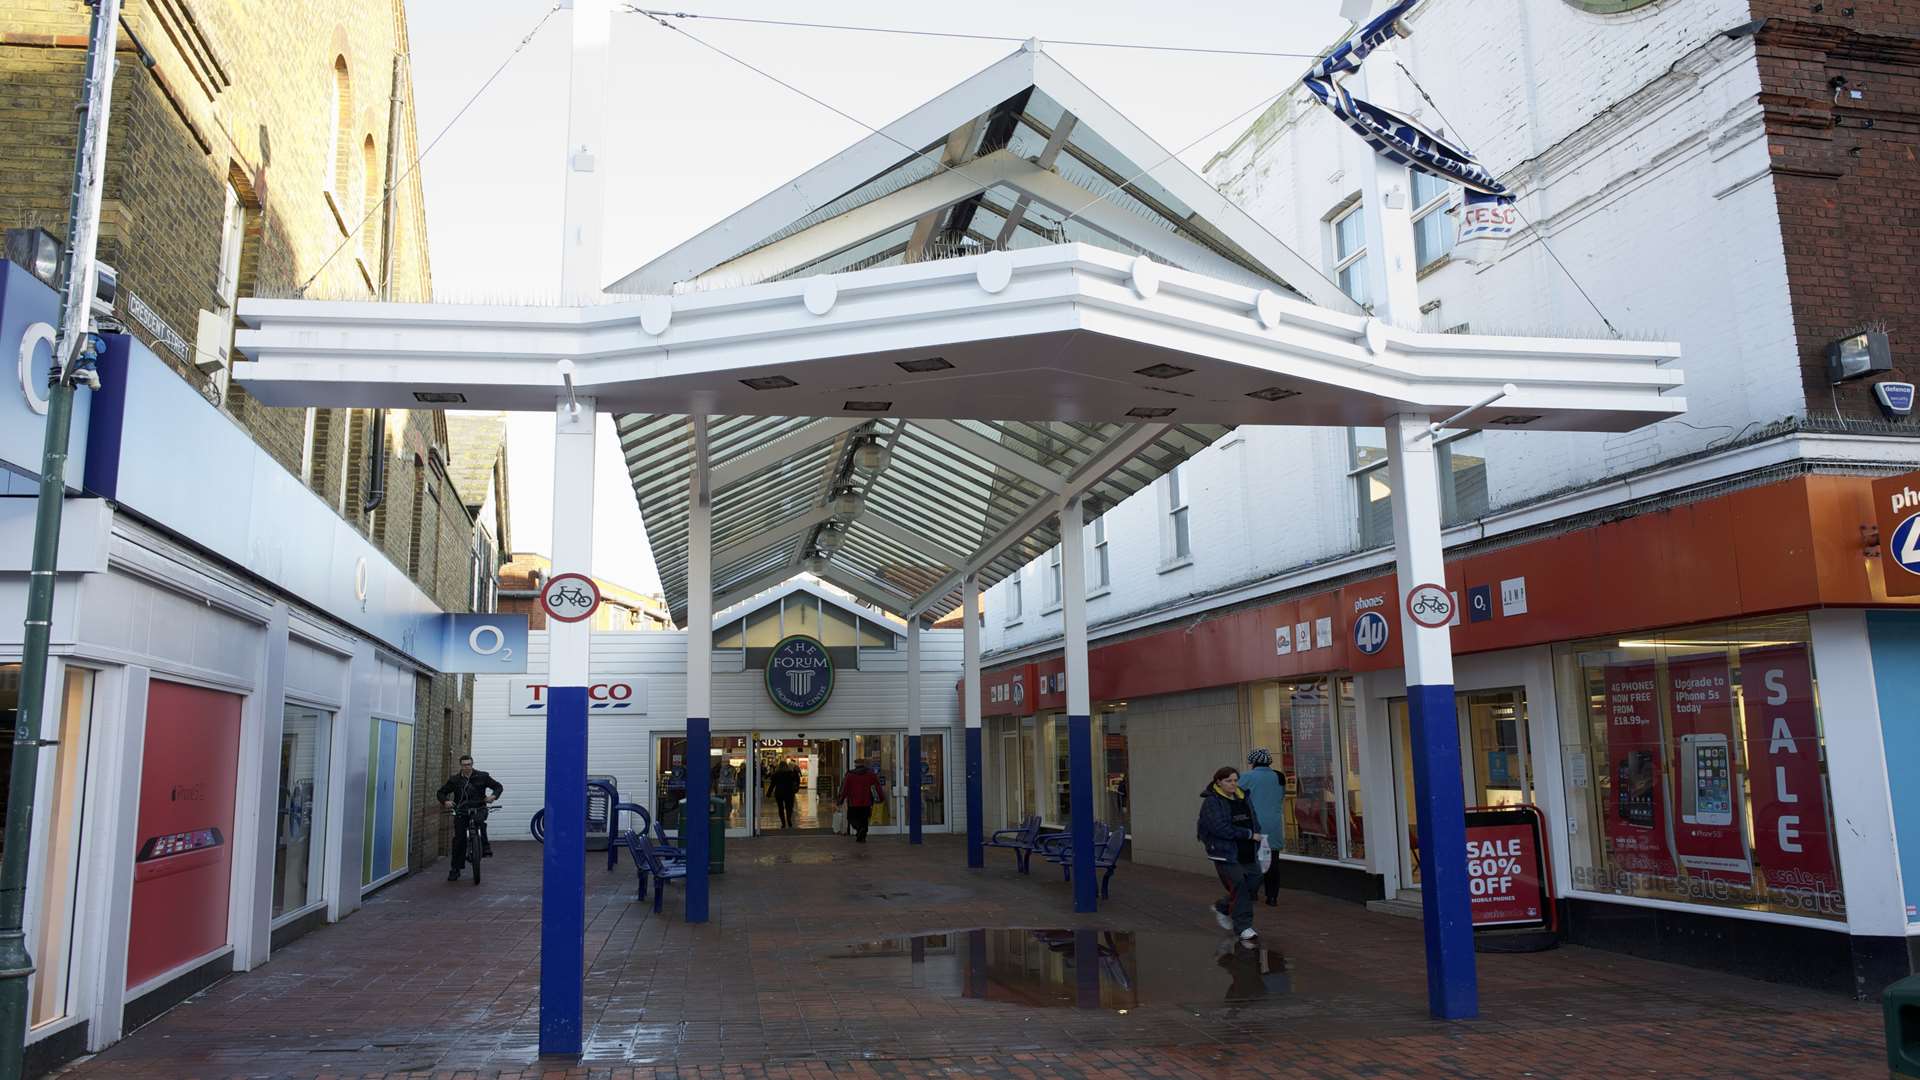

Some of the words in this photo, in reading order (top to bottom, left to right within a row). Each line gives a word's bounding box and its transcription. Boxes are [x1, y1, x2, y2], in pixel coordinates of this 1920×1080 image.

[130, 295, 166, 341] CRESCENT
[1354, 595, 1384, 613] phones
[1474, 594, 1486, 611] O2
[1358, 616, 1383, 651] 4u
[469, 625, 513, 662] O2
[784, 642, 817, 656] THE
[774, 657, 828, 669] FORUM
[525, 683, 633, 701] TCO
[1621, 680, 1655, 691] PHONES
[1674, 677, 1712, 691] Upgrade
[1714, 677, 1724, 686] to
[1612, 695, 1628, 704] NOW
[1630, 693, 1651, 702] FREE
[1613, 705, 1634, 715] FROM
[1676, 703, 1701, 714] today
[1764, 669, 1803, 853] SALE
[1466, 839, 1522, 859] SALE
[1468, 857, 1522, 877] 60%
[1470, 876, 1512, 895] OFF
